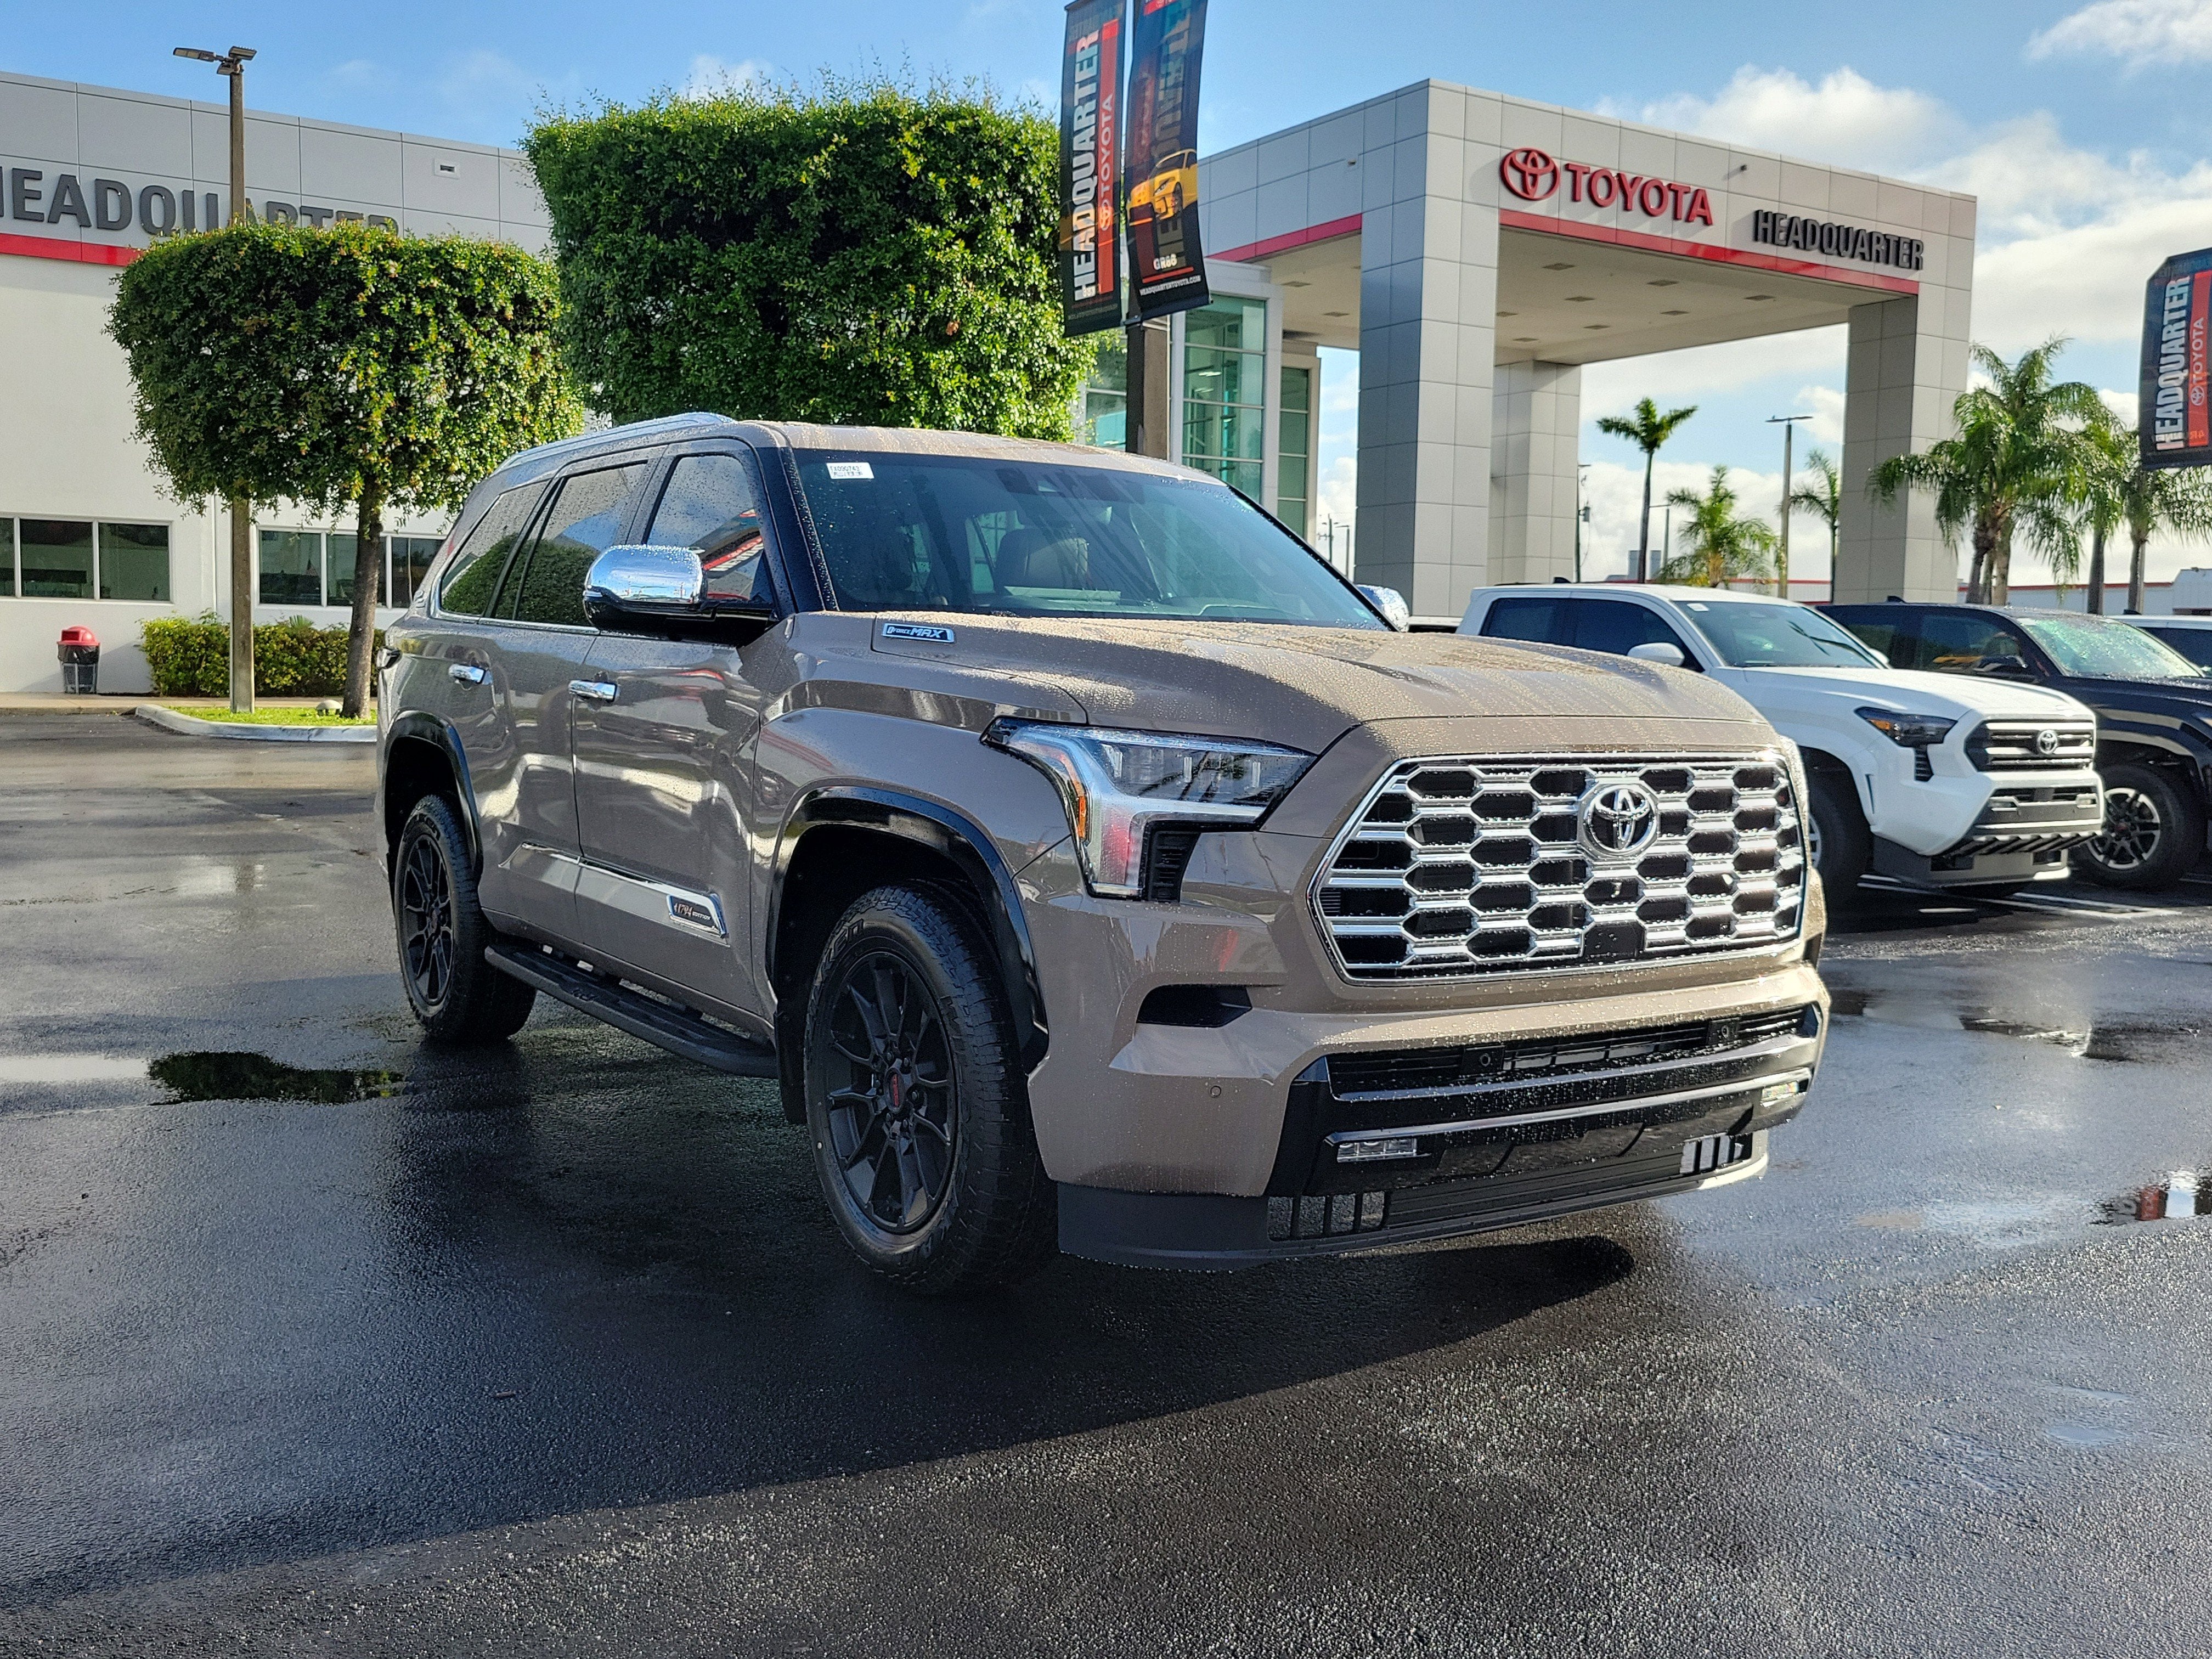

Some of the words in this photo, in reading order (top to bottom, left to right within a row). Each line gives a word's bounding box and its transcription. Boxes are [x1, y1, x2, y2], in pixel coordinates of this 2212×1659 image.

[1071, 30, 1099, 301] HEADQUARTER
[1101, 94, 1113, 198] TOYOTA
[1565, 162, 1713, 226] TOYOTA
[1753, 209, 1924, 271] HEADQUARTER
[2156, 275, 2190, 451] HEADQUARTER
[2192, 317, 2204, 385] TOYOTA
[910, 628, 944, 638] MAX
